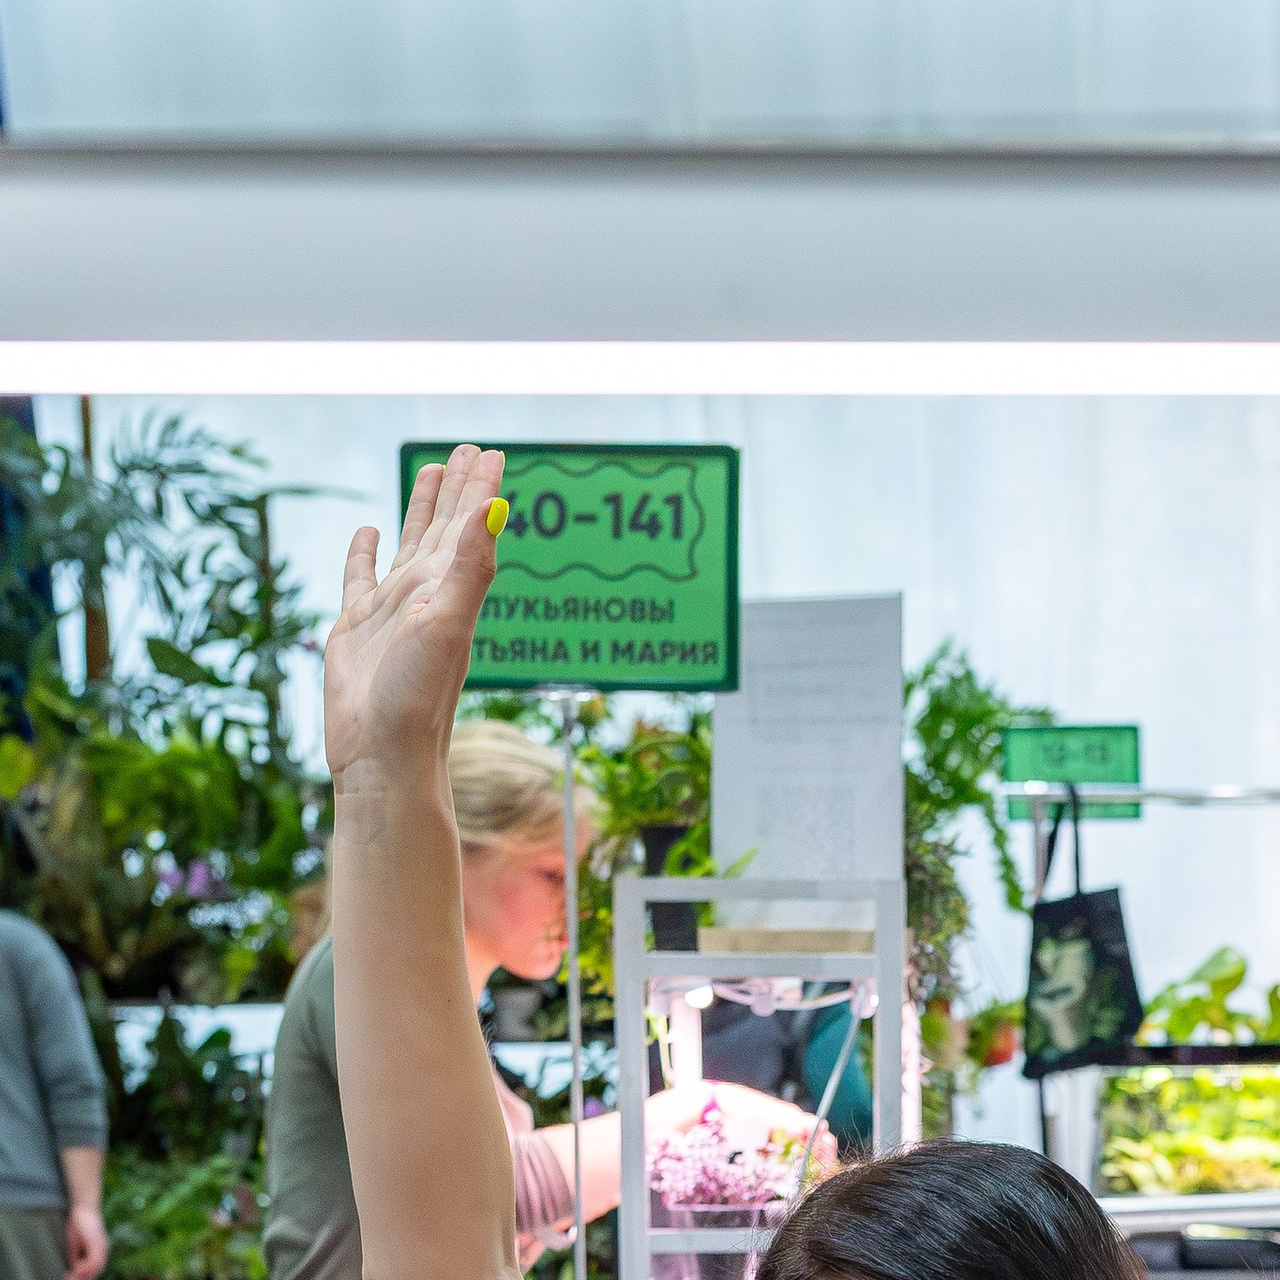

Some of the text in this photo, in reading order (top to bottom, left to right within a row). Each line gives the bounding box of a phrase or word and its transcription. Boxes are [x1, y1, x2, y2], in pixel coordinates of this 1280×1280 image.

[506, 490, 684, 540] 40-141
[473, 637, 719, 665] ТЬЯНА И МАРИЯ
